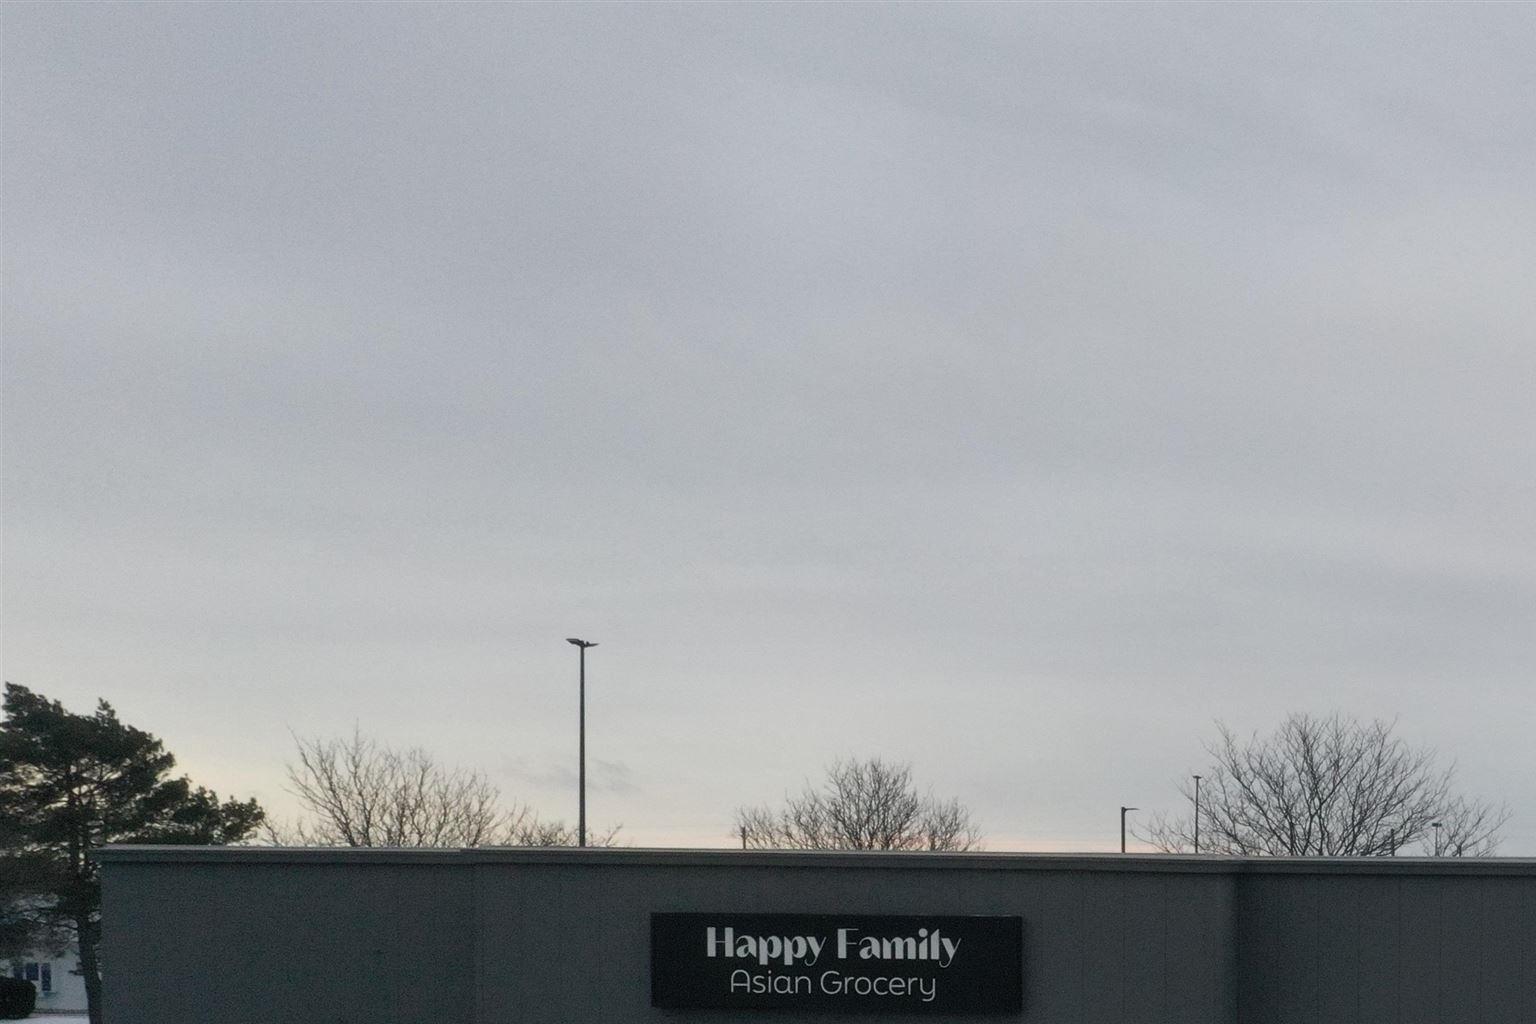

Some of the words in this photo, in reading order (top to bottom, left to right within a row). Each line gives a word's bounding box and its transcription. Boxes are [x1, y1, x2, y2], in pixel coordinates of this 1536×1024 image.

[706, 926, 827, 966] Happy
[836, 927, 961, 968] Family
[730, 969, 812, 995] Asian
[819, 970, 936, 1002] Grocery
